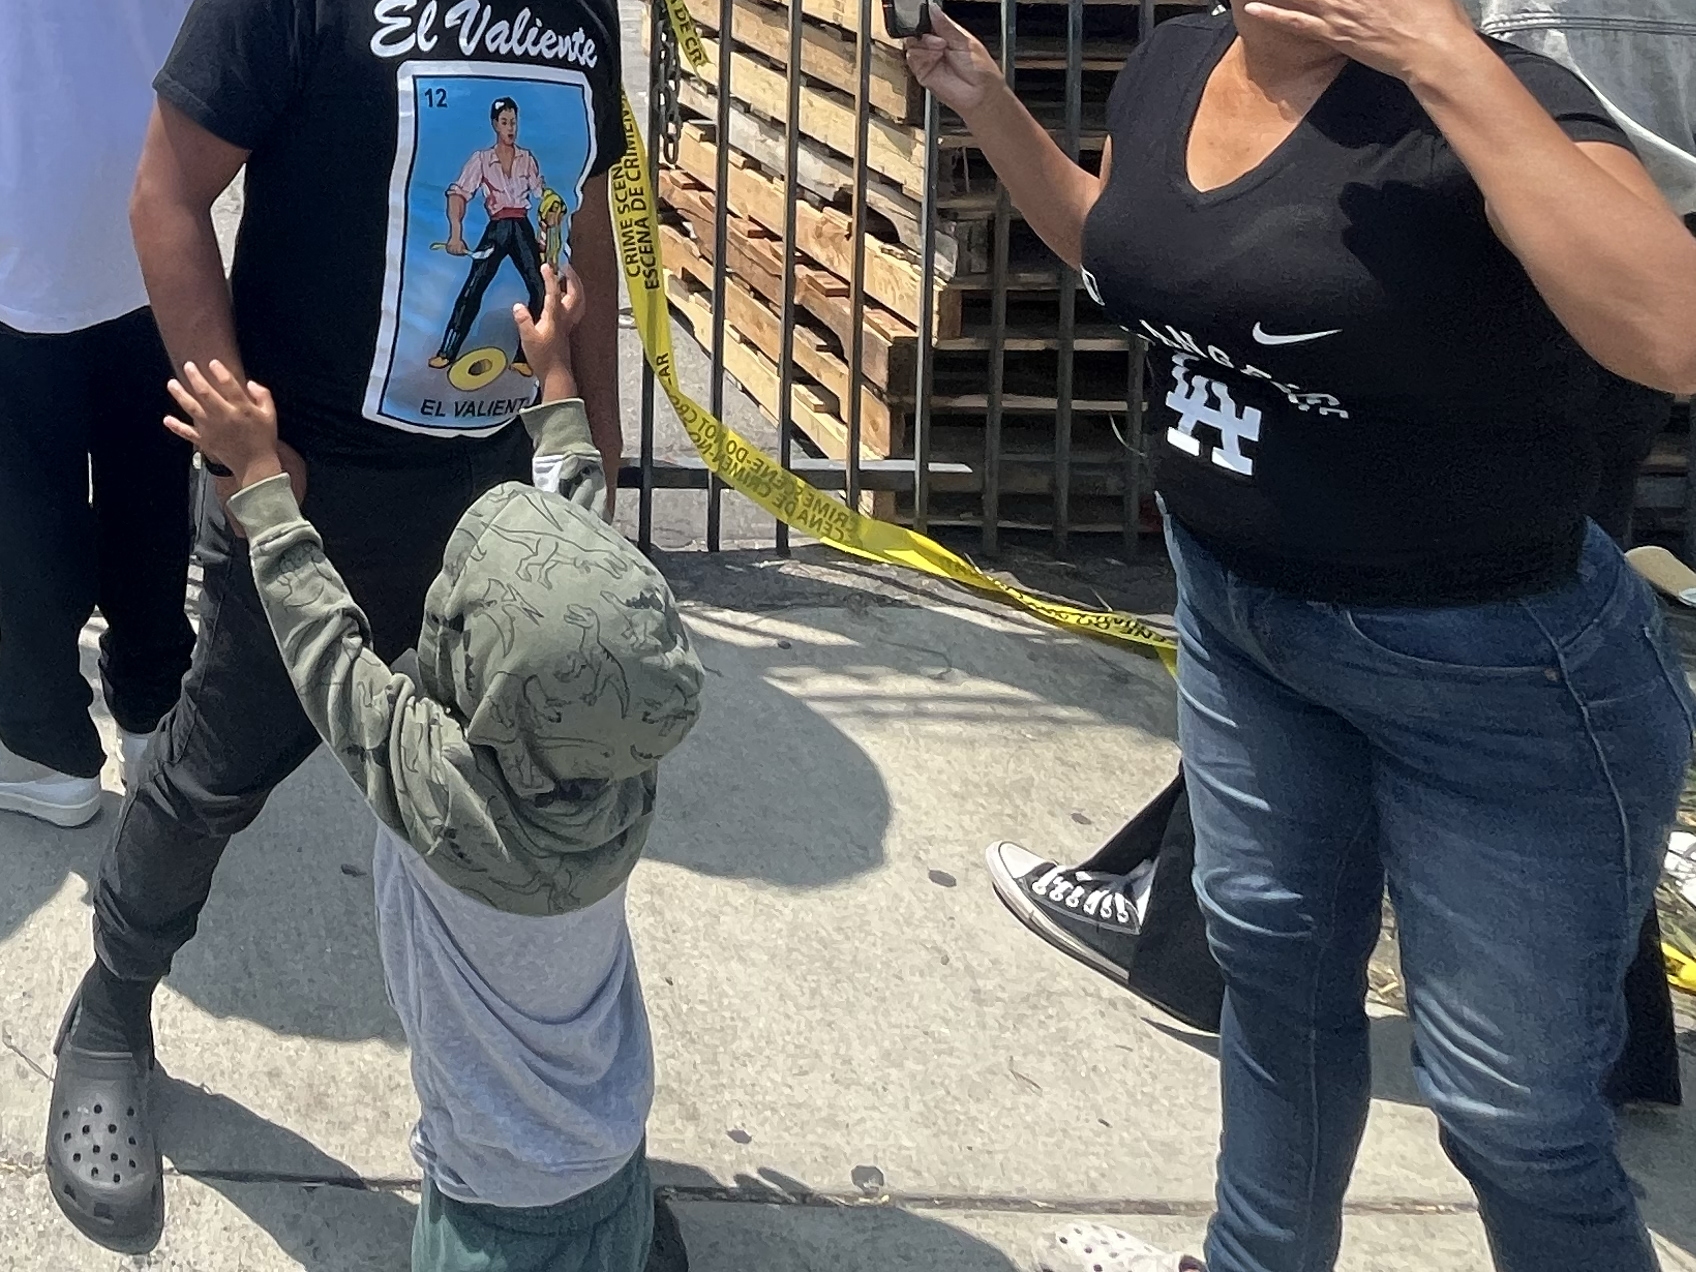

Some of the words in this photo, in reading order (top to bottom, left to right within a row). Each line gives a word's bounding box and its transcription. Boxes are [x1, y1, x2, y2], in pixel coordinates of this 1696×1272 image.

[424, 88, 448, 108] 12
[611, 164, 631, 215] SCEN
[628, 185, 647, 212] DE
[619, 217, 641, 278] CRIME
[634, 216, 660, 290] ESCENA
[420, 398, 446, 417] EL
[454, 396, 531, 418] VALIENT
